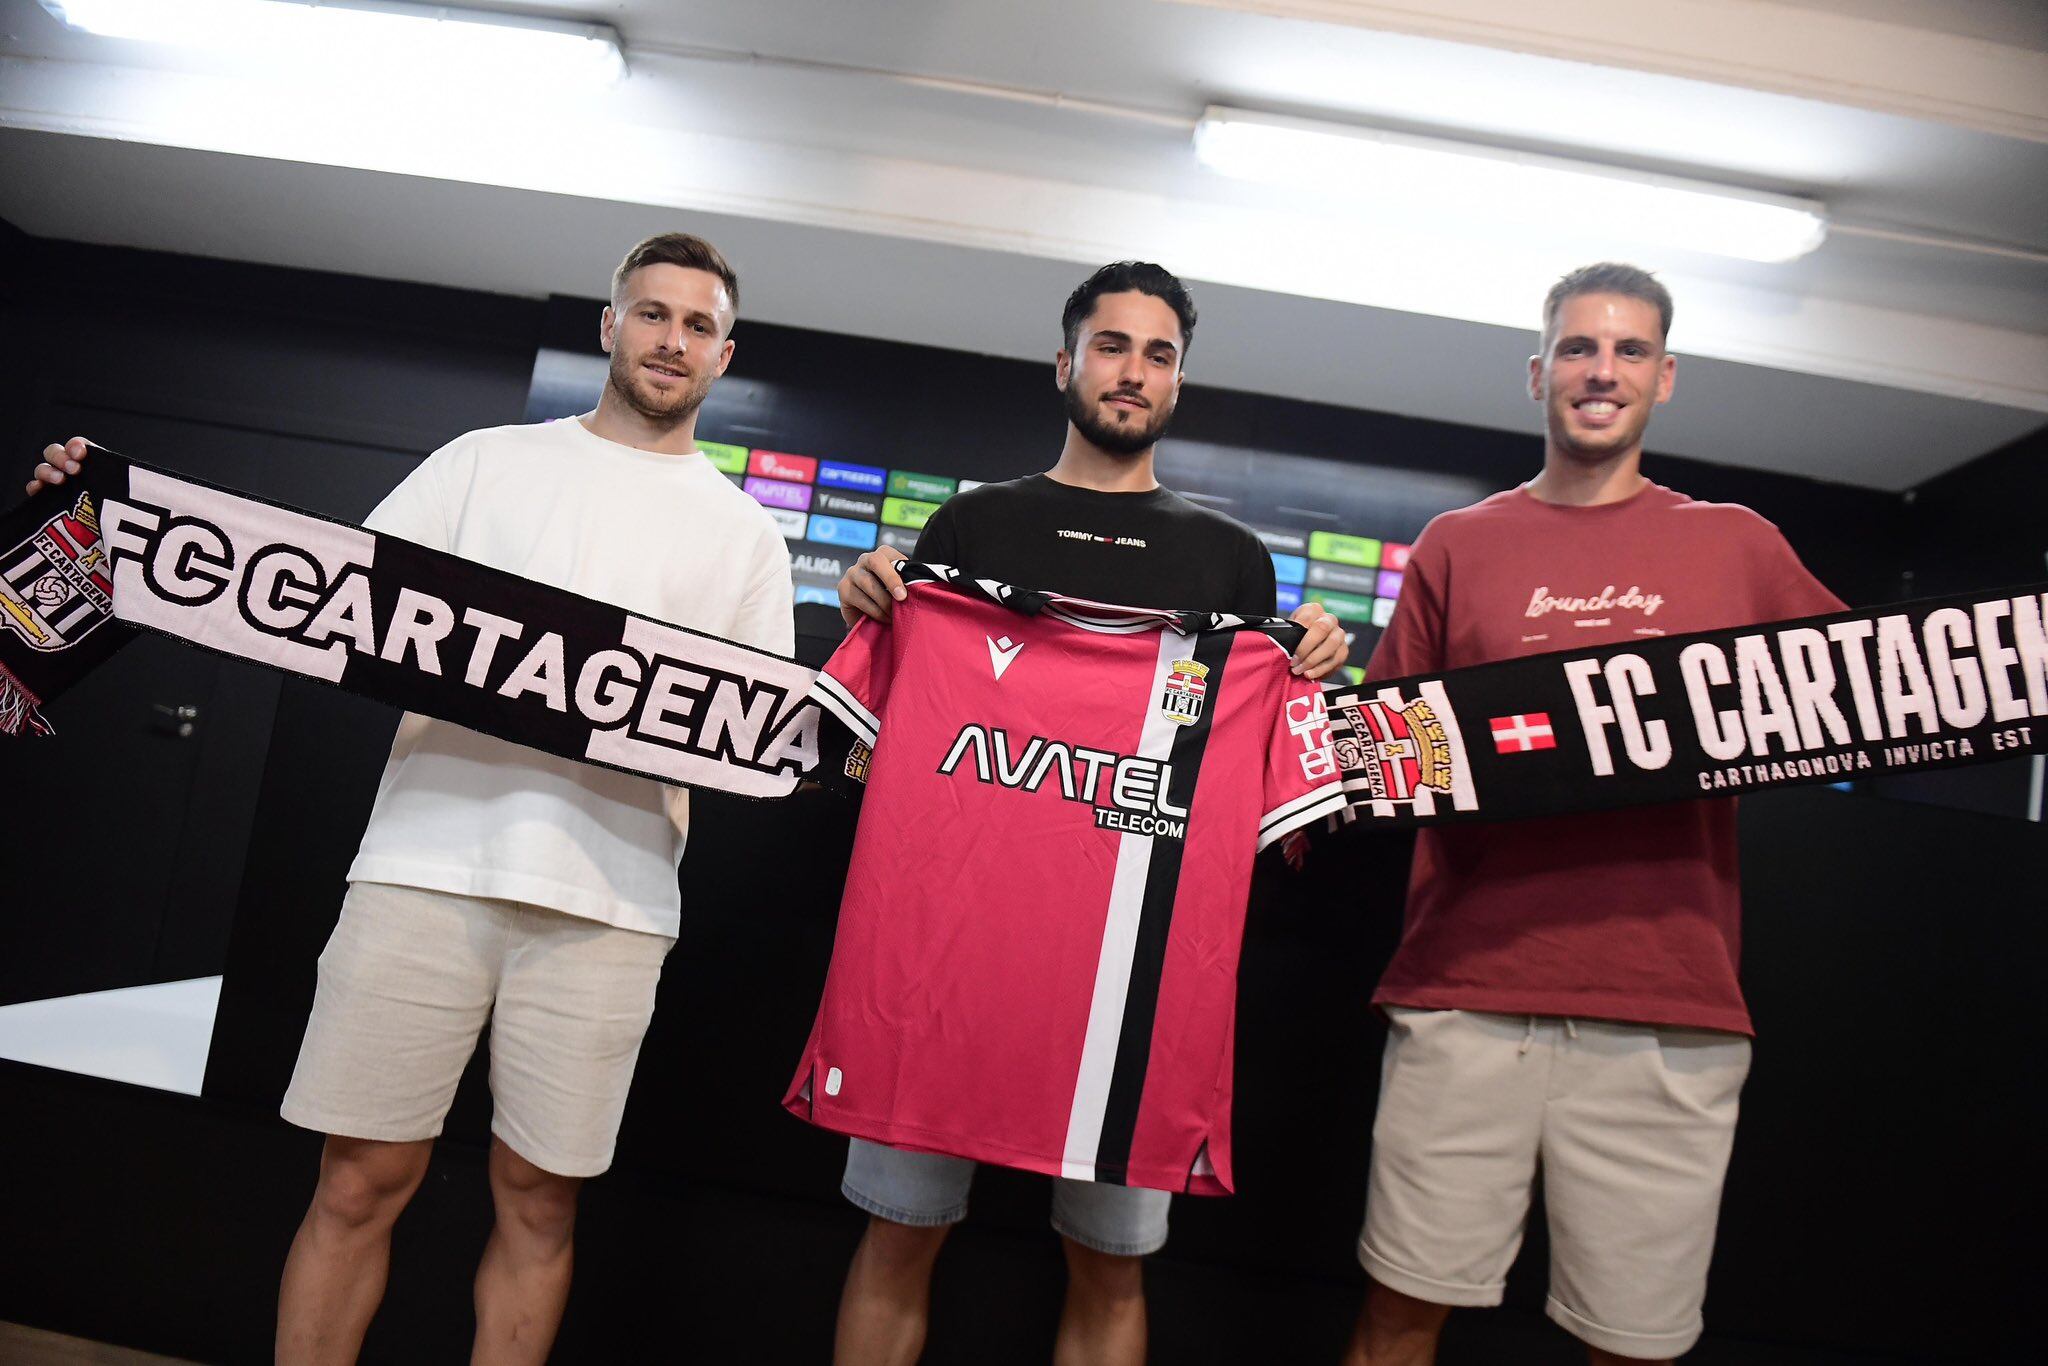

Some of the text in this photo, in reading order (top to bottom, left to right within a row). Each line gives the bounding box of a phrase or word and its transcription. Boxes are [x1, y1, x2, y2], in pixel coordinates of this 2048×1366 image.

[35, 533, 113, 613] FC CARTAGENA
[1057, 530, 1147, 548] TOMMY JEANS
[100, 499, 821, 772] FC CARTAGENA
[1344, 707, 1385, 797] FC CARTAGENA
[1564, 653, 1673, 777] FC
[937, 722, 1188, 819] AVATEL
[1698, 727, 2033, 791] CARTHAGONOVA INVICTA EST
[1095, 807, 1185, 840] TELECOM
